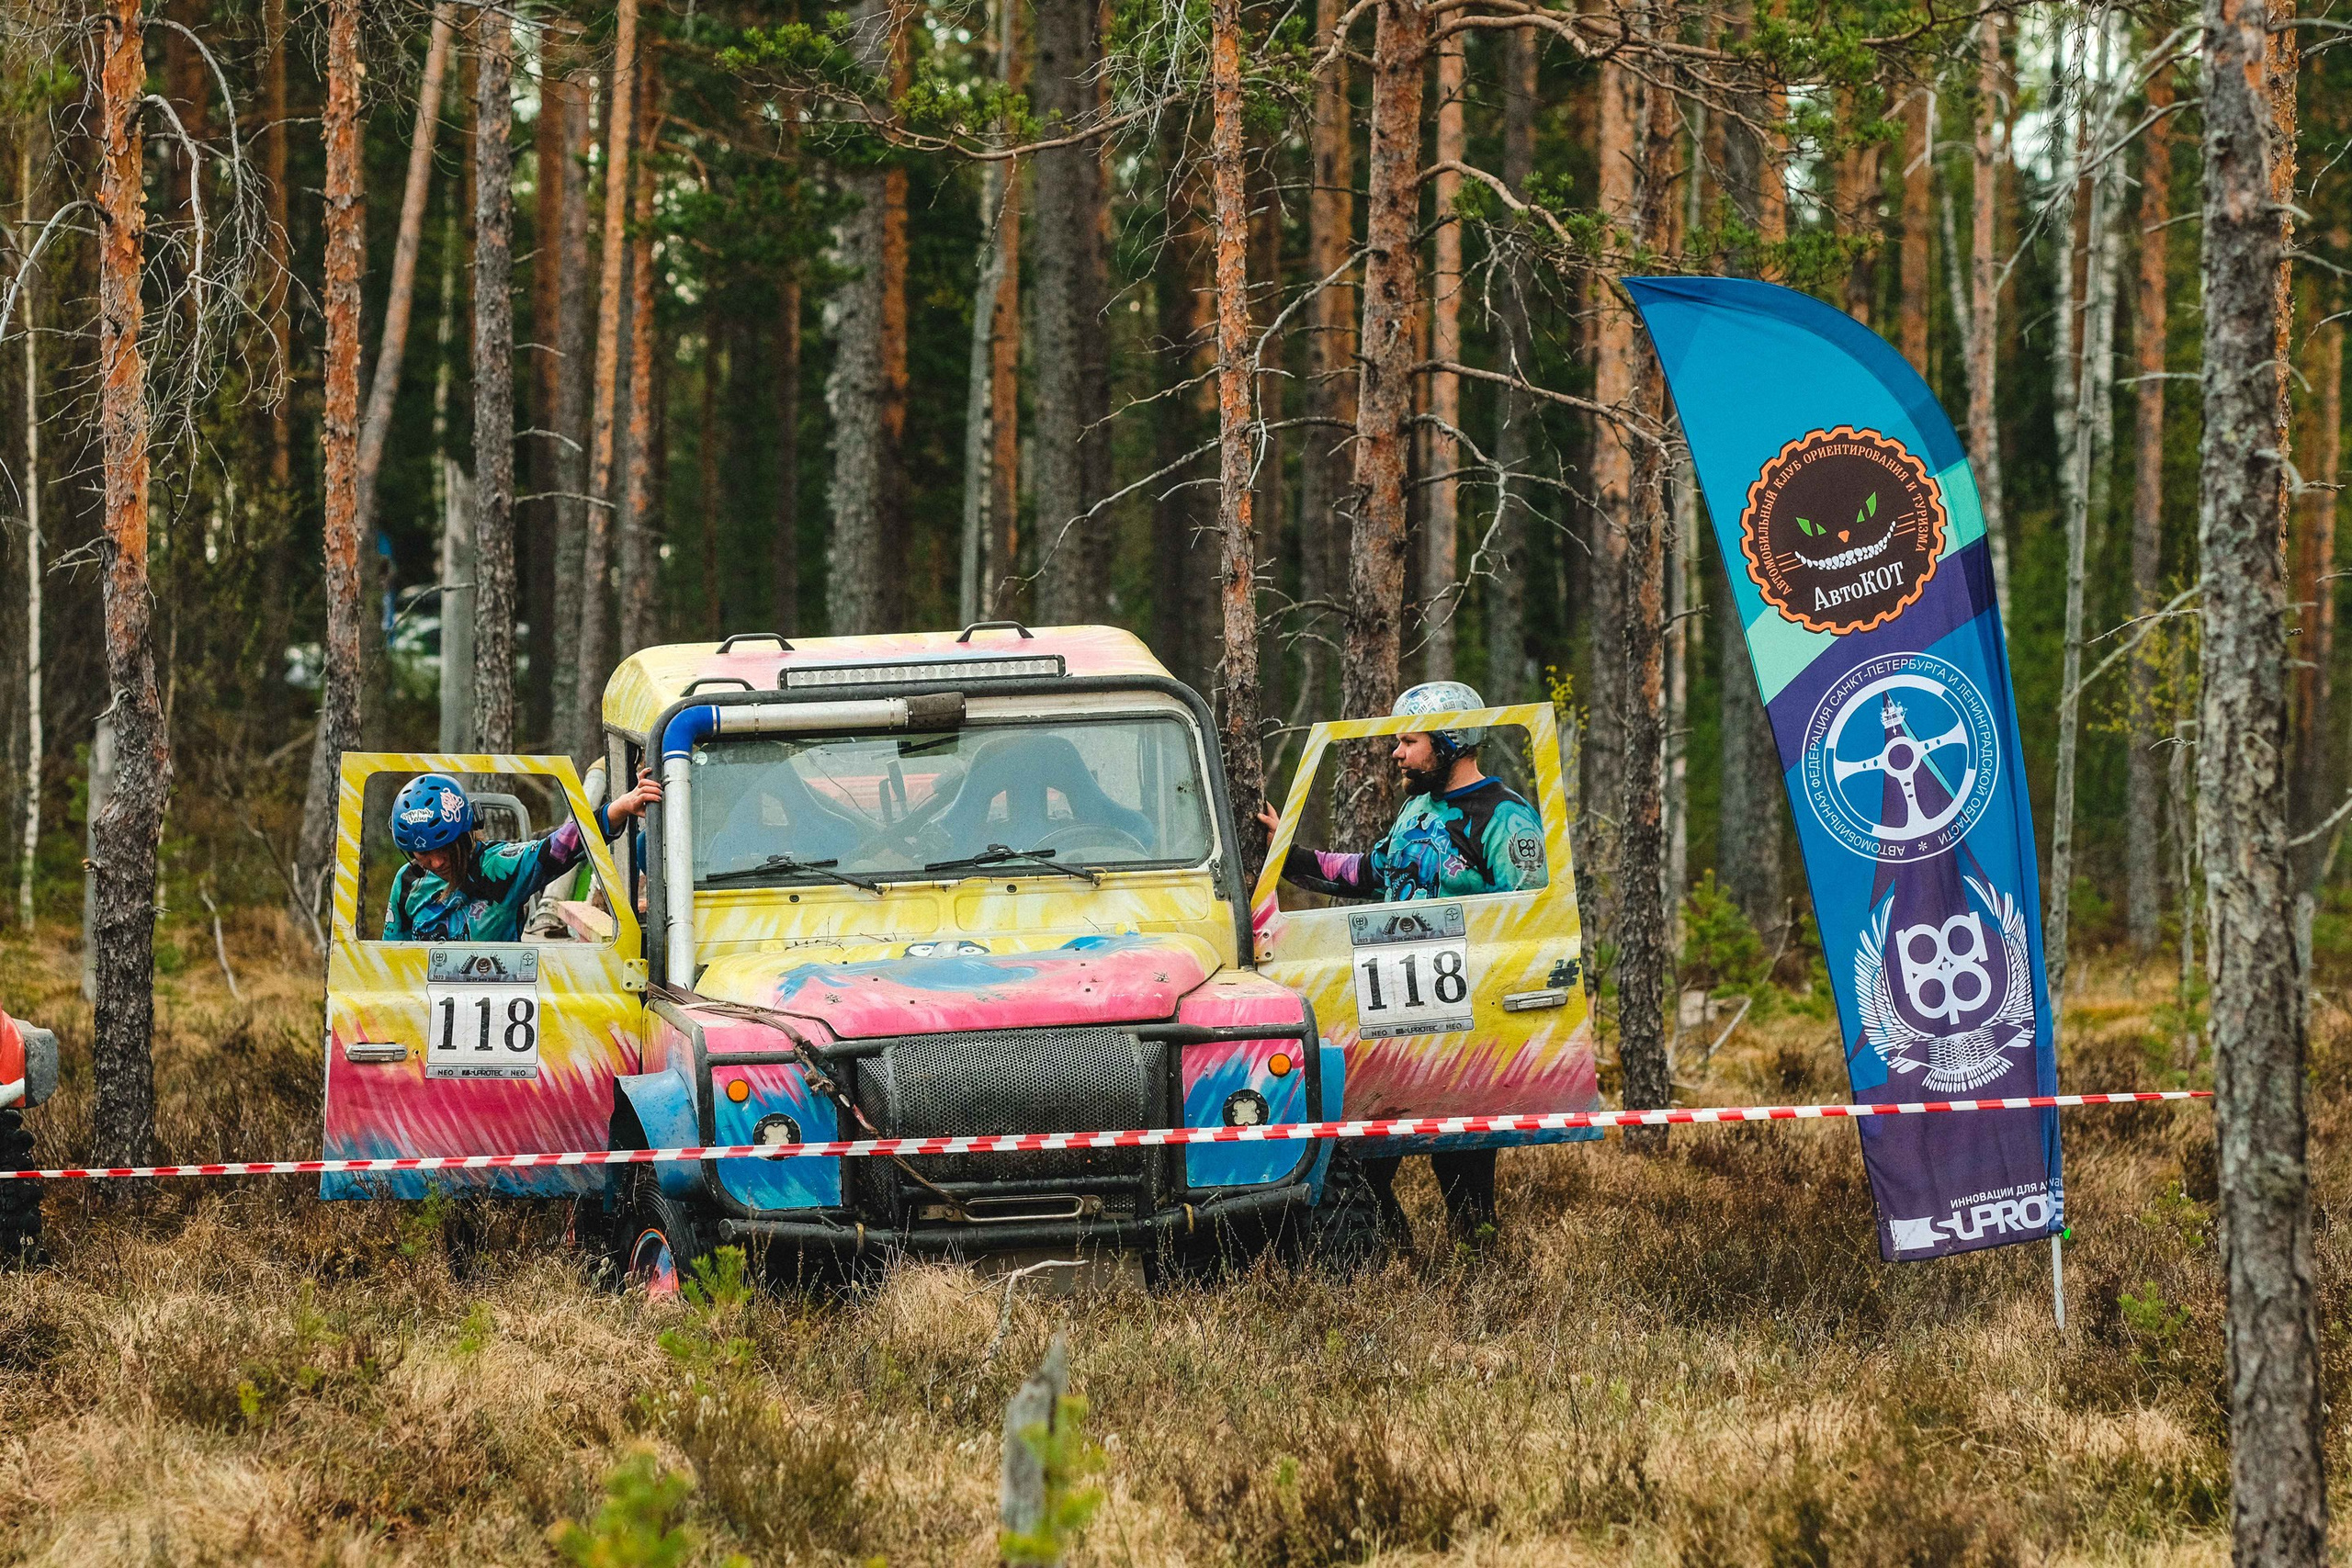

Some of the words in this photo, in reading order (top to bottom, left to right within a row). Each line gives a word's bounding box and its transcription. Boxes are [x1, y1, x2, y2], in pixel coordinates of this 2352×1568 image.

[1773, 460, 1802, 490] КЛУБ
[1803, 444, 1909, 482] ОРИЕНТИРОВАНИЯ
[1905, 481, 1917, 492] И
[1758, 490, 1792, 595] АВТОМОБИЛЬНЫЙ
[1912, 493, 1928, 552] ТУРИЗМА
[1829, 659, 1946, 706] САНКТ-ПЕТЕРБУРГА
[1948, 672, 1960, 685] И
[1808, 705, 1833, 787] ФЕДЕРАЦИЯ
[1956, 683, 1993, 796] ЛЕНИНГРАДСКОЙ
[1814, 789, 1905, 856] АВТОМОБИЛЬНАЯ
[1938, 797, 1982, 845] ОБЛАСТИ
[1362, 951, 1467, 1010] 118
[437, 997, 535, 1053] 118
[1446, 1022, 1462, 1031] NEO
[1930, 1193, 2048, 1240] SUPRO
[1951, 1187, 2015, 1209] ИННОВАЦИИ
[2016, 1182, 2038, 1197] ДЛЯ
